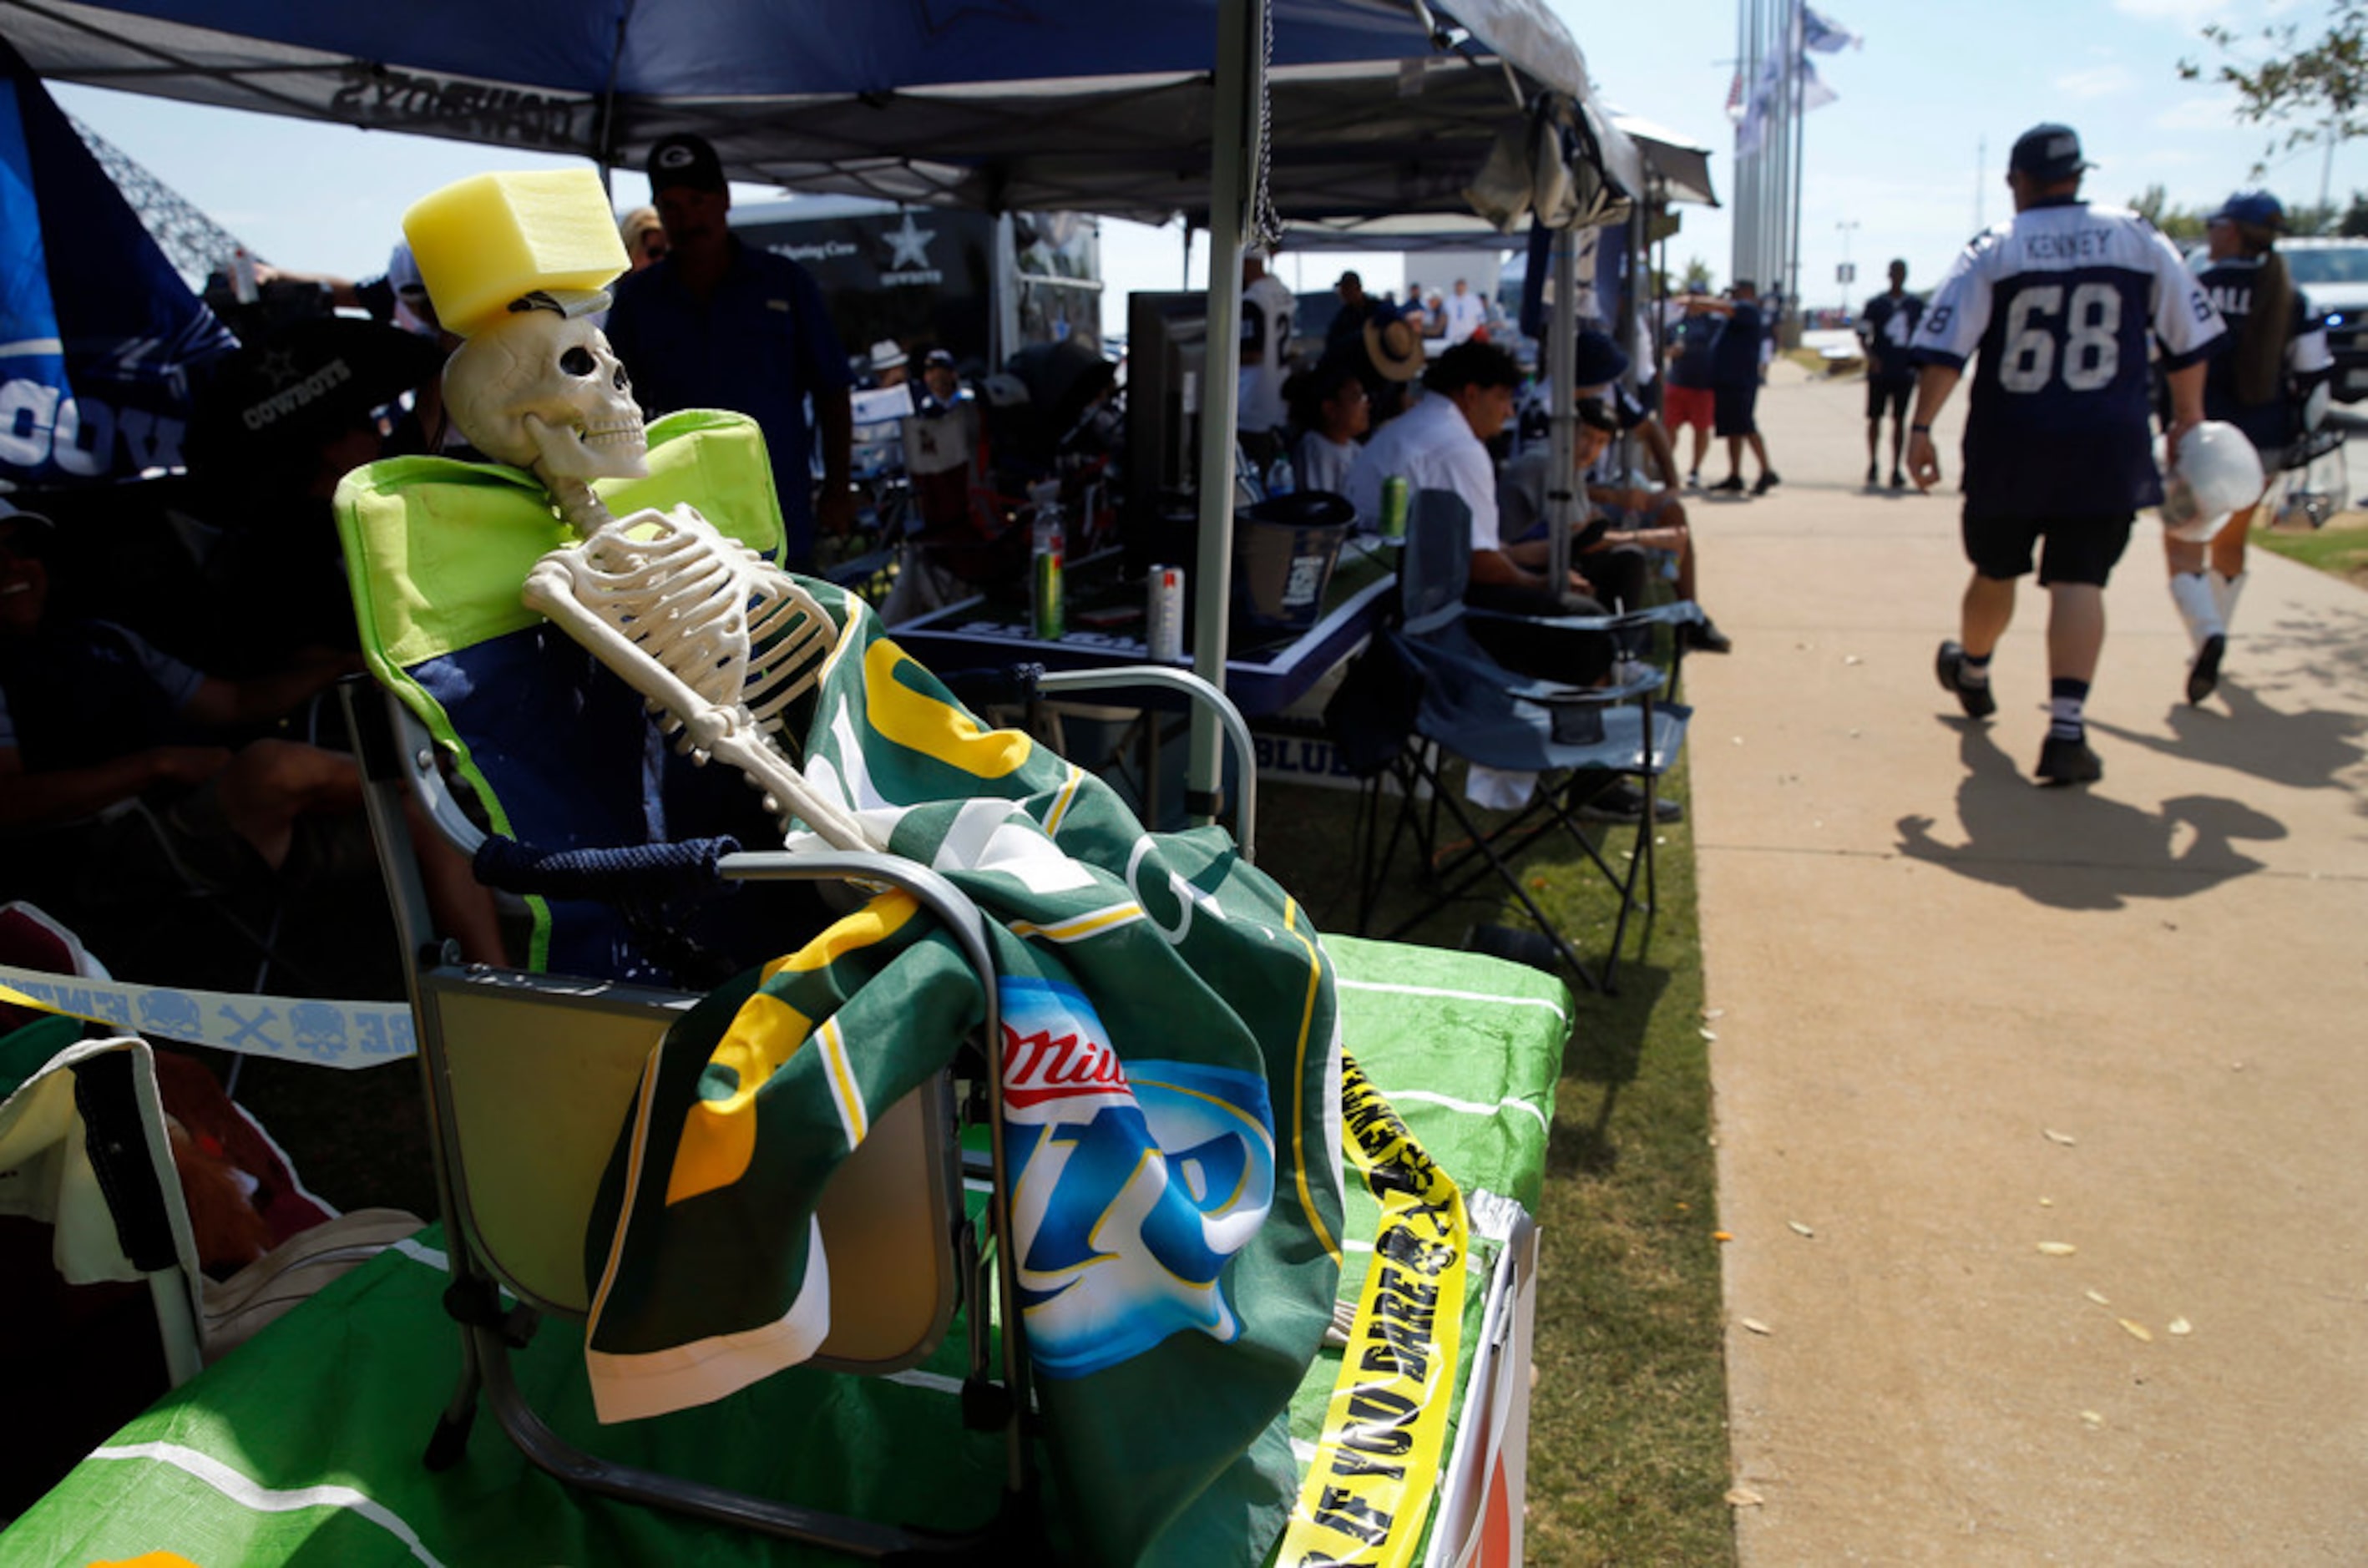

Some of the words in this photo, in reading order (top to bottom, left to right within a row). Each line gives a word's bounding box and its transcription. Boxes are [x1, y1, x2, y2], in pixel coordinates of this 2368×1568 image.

[2025, 228, 2112, 260] KENNEY
[1998, 282, 2123, 393] 68
[242, 357, 352, 431] COWBOYS
[1359, 1267, 1440, 1384] DARE
[1331, 1382, 1420, 1481] YOU
[1313, 1484, 1394, 1546] IF
